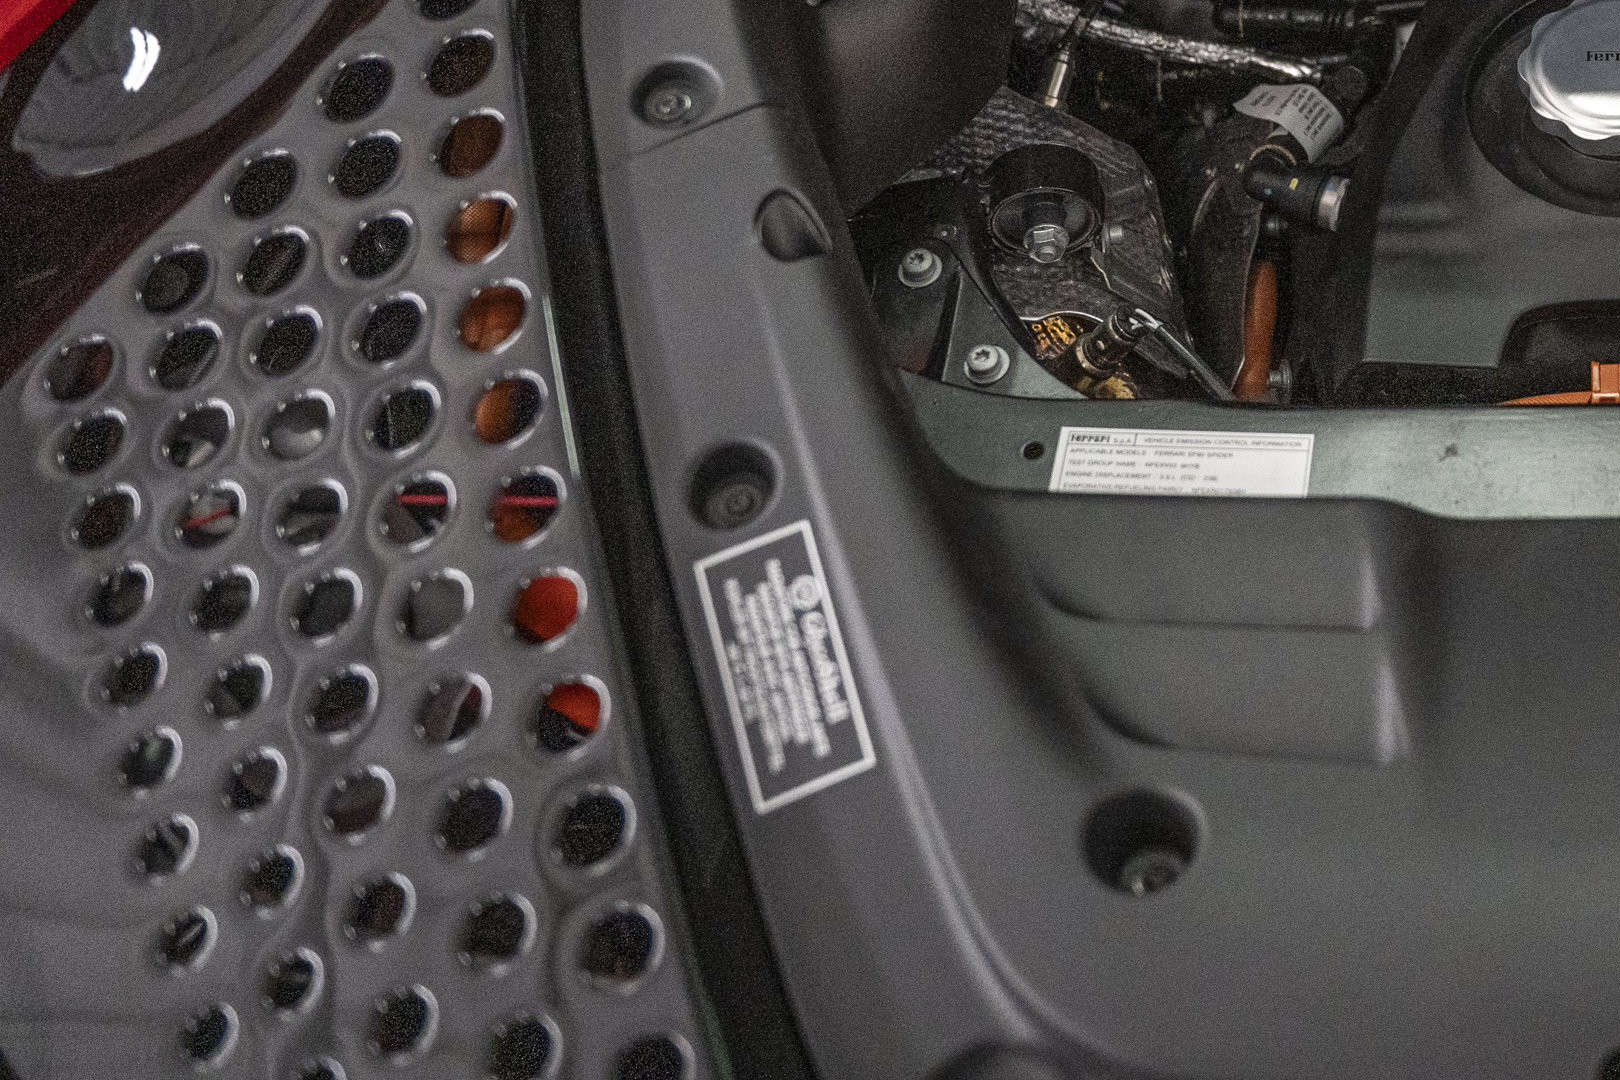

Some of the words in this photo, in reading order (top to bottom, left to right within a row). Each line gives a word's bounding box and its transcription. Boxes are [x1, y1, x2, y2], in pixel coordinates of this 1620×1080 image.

[1070, 433, 1111, 443] Ferrari
[1144, 437, 1174, 445] VEHICLE
[1070, 447, 1113, 455] APPLICABLE
[1115, 448, 1147, 456] MODELS
[1094, 472, 1152, 480] DISPLACEMENT
